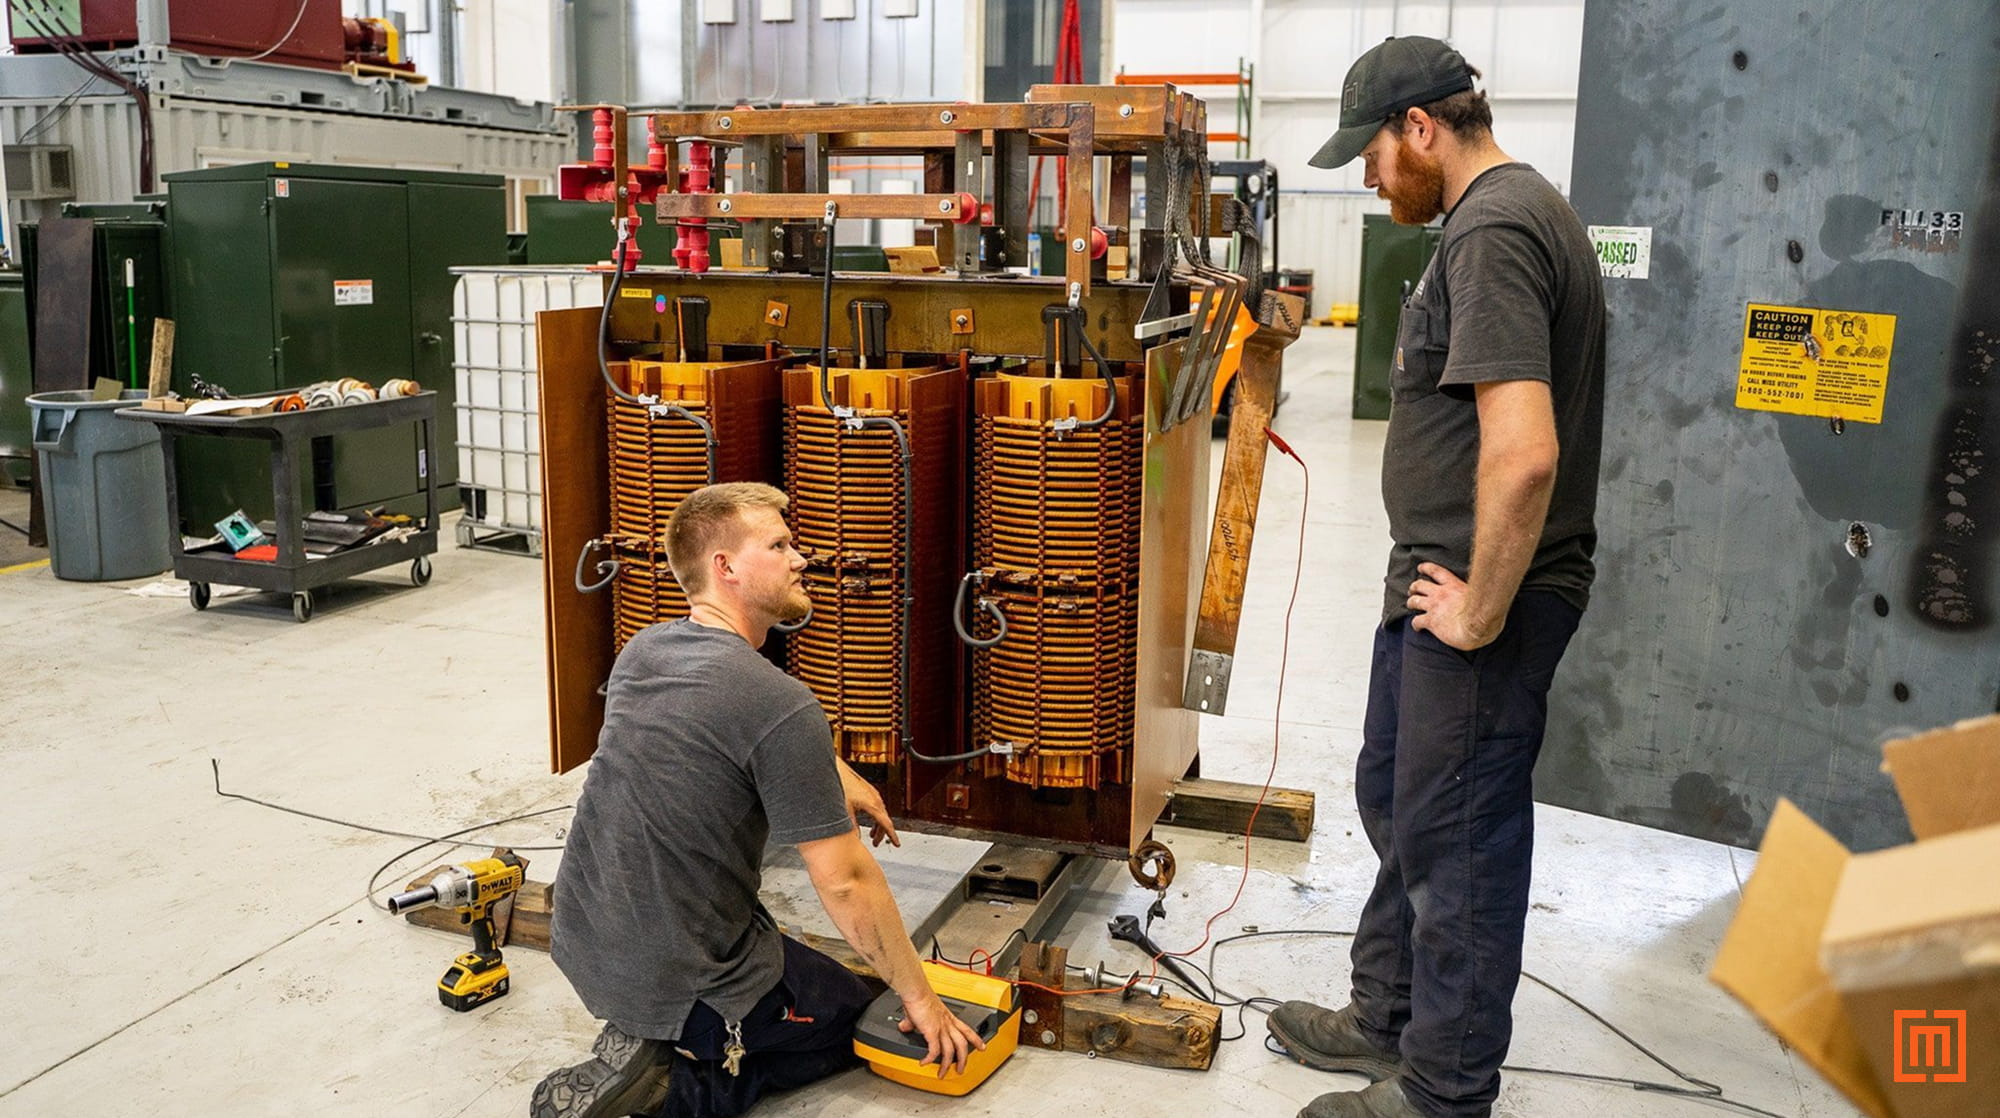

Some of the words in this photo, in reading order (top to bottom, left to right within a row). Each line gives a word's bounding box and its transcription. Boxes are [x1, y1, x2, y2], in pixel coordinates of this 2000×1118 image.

[1596, 241, 1637, 264] PASSED
[1755, 311, 1809, 324] CAUTION
[1756, 323, 1782, 331] KEEP
[1755, 331, 1780, 339] KEEP
[1783, 333, 1803, 341] OUT
